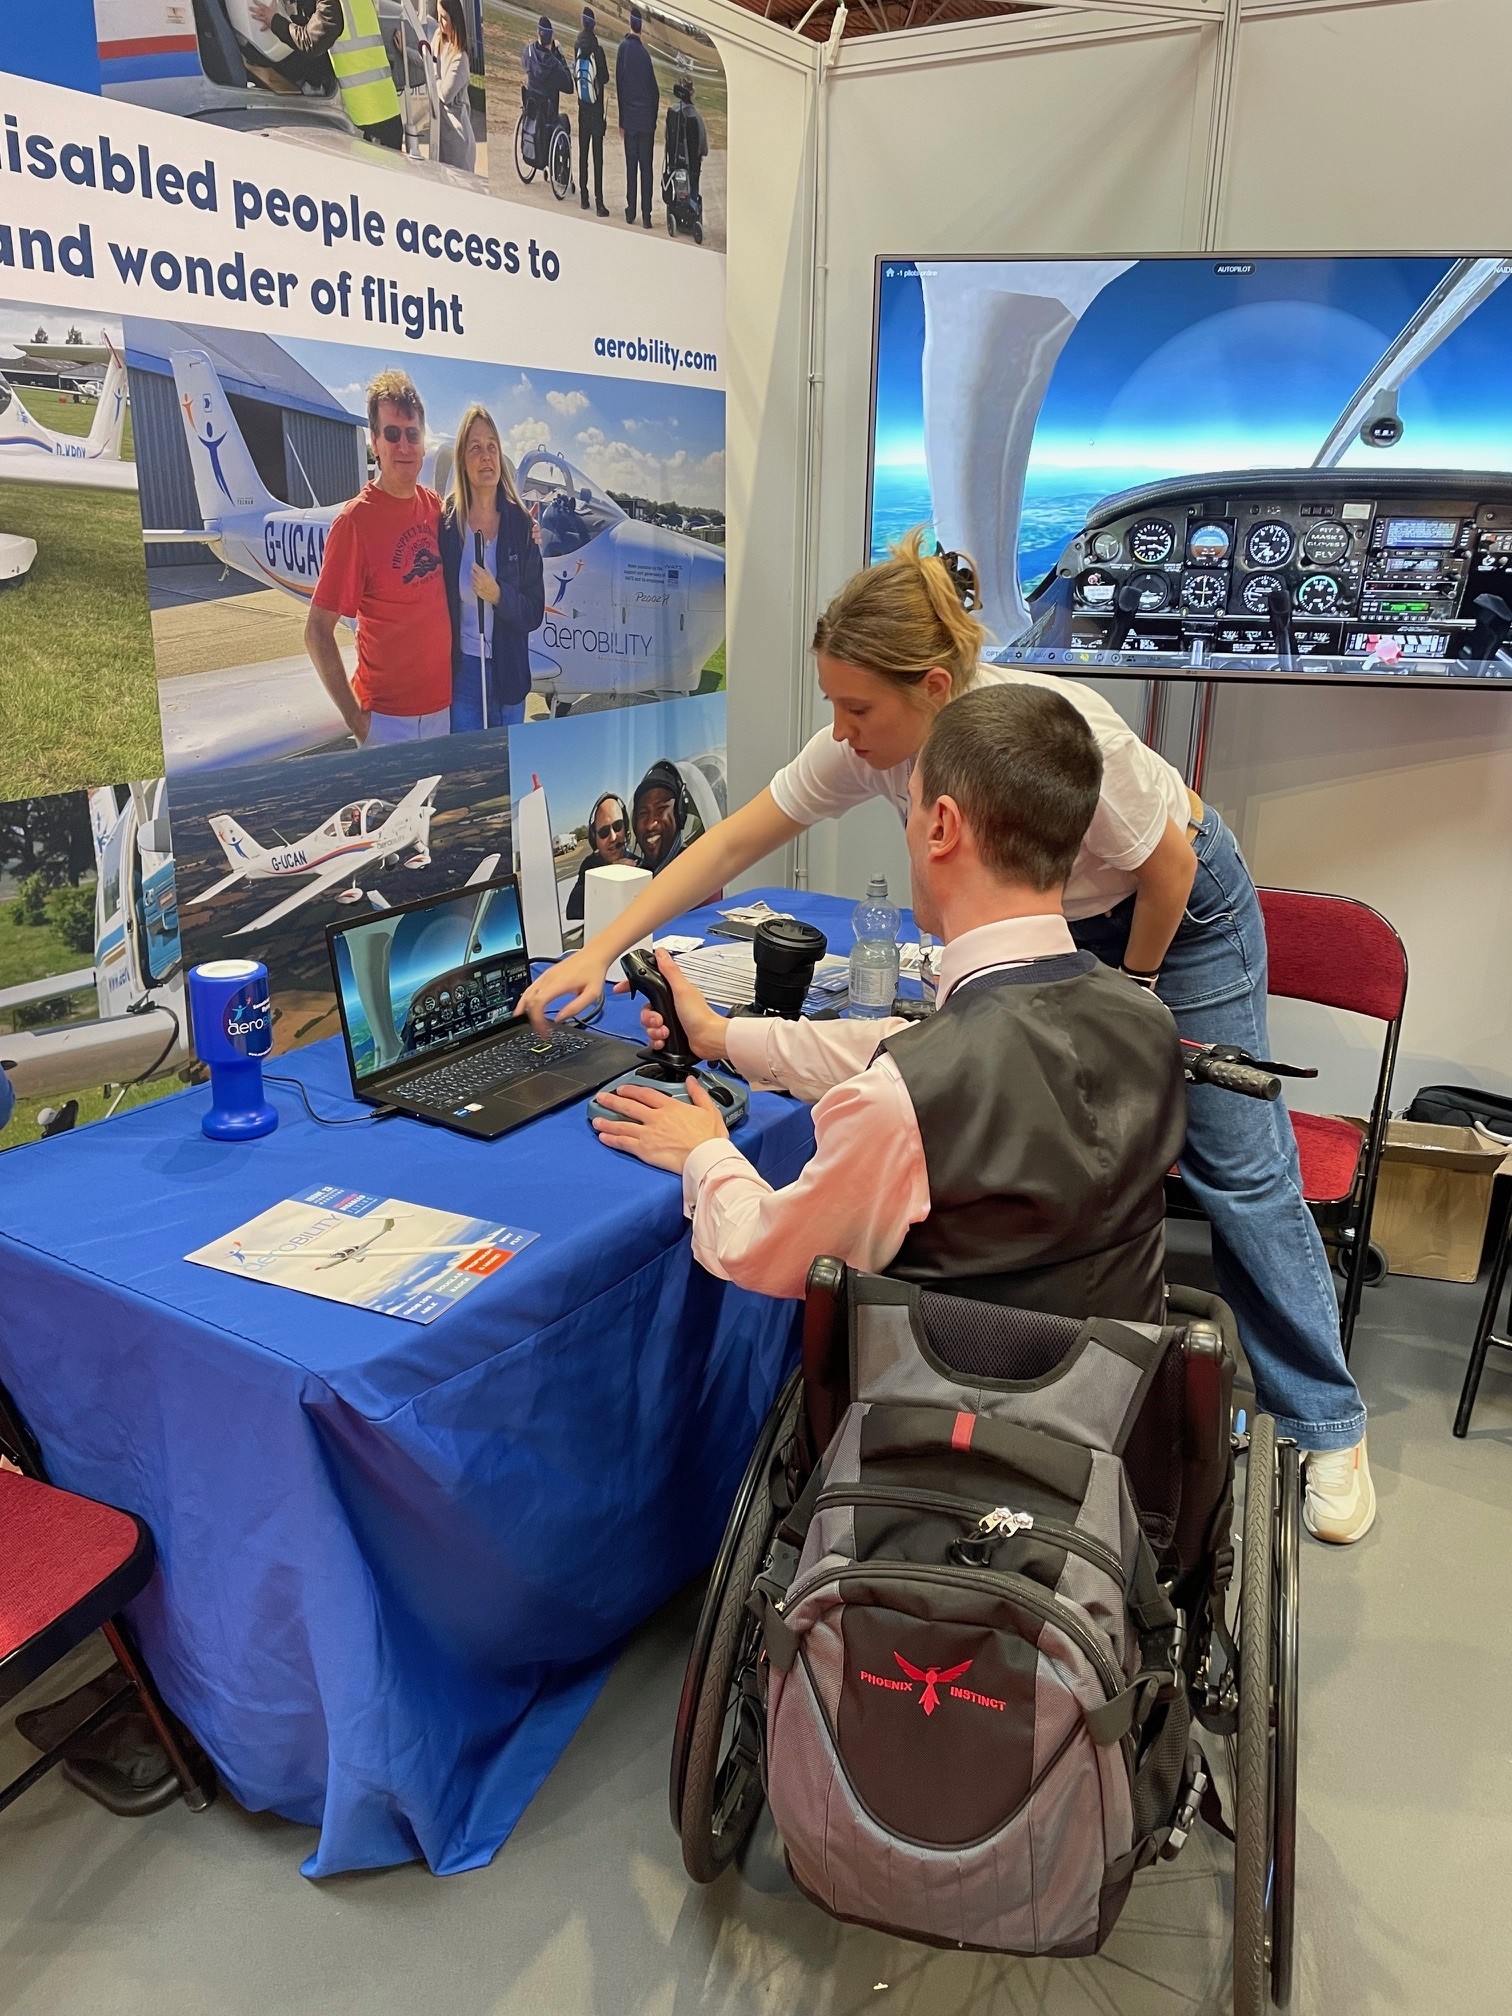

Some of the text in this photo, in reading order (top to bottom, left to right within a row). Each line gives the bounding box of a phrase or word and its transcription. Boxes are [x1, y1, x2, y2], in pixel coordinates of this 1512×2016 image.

[0, 113, 560, 281] isabled people access to
[1217, 265, 1252, 273] AUTOPILOT
[108, 242, 298, 308] wonder
[310, 271, 351, 317] of
[362, 275, 465, 340] flight
[594, 336, 717, 372] aerobility.com
[1315, 551, 1336, 559] FLY
[271, 851, 308, 871] G-UCAN
[860, 1670, 1007, 1711] PHOENIX INSTINCT
